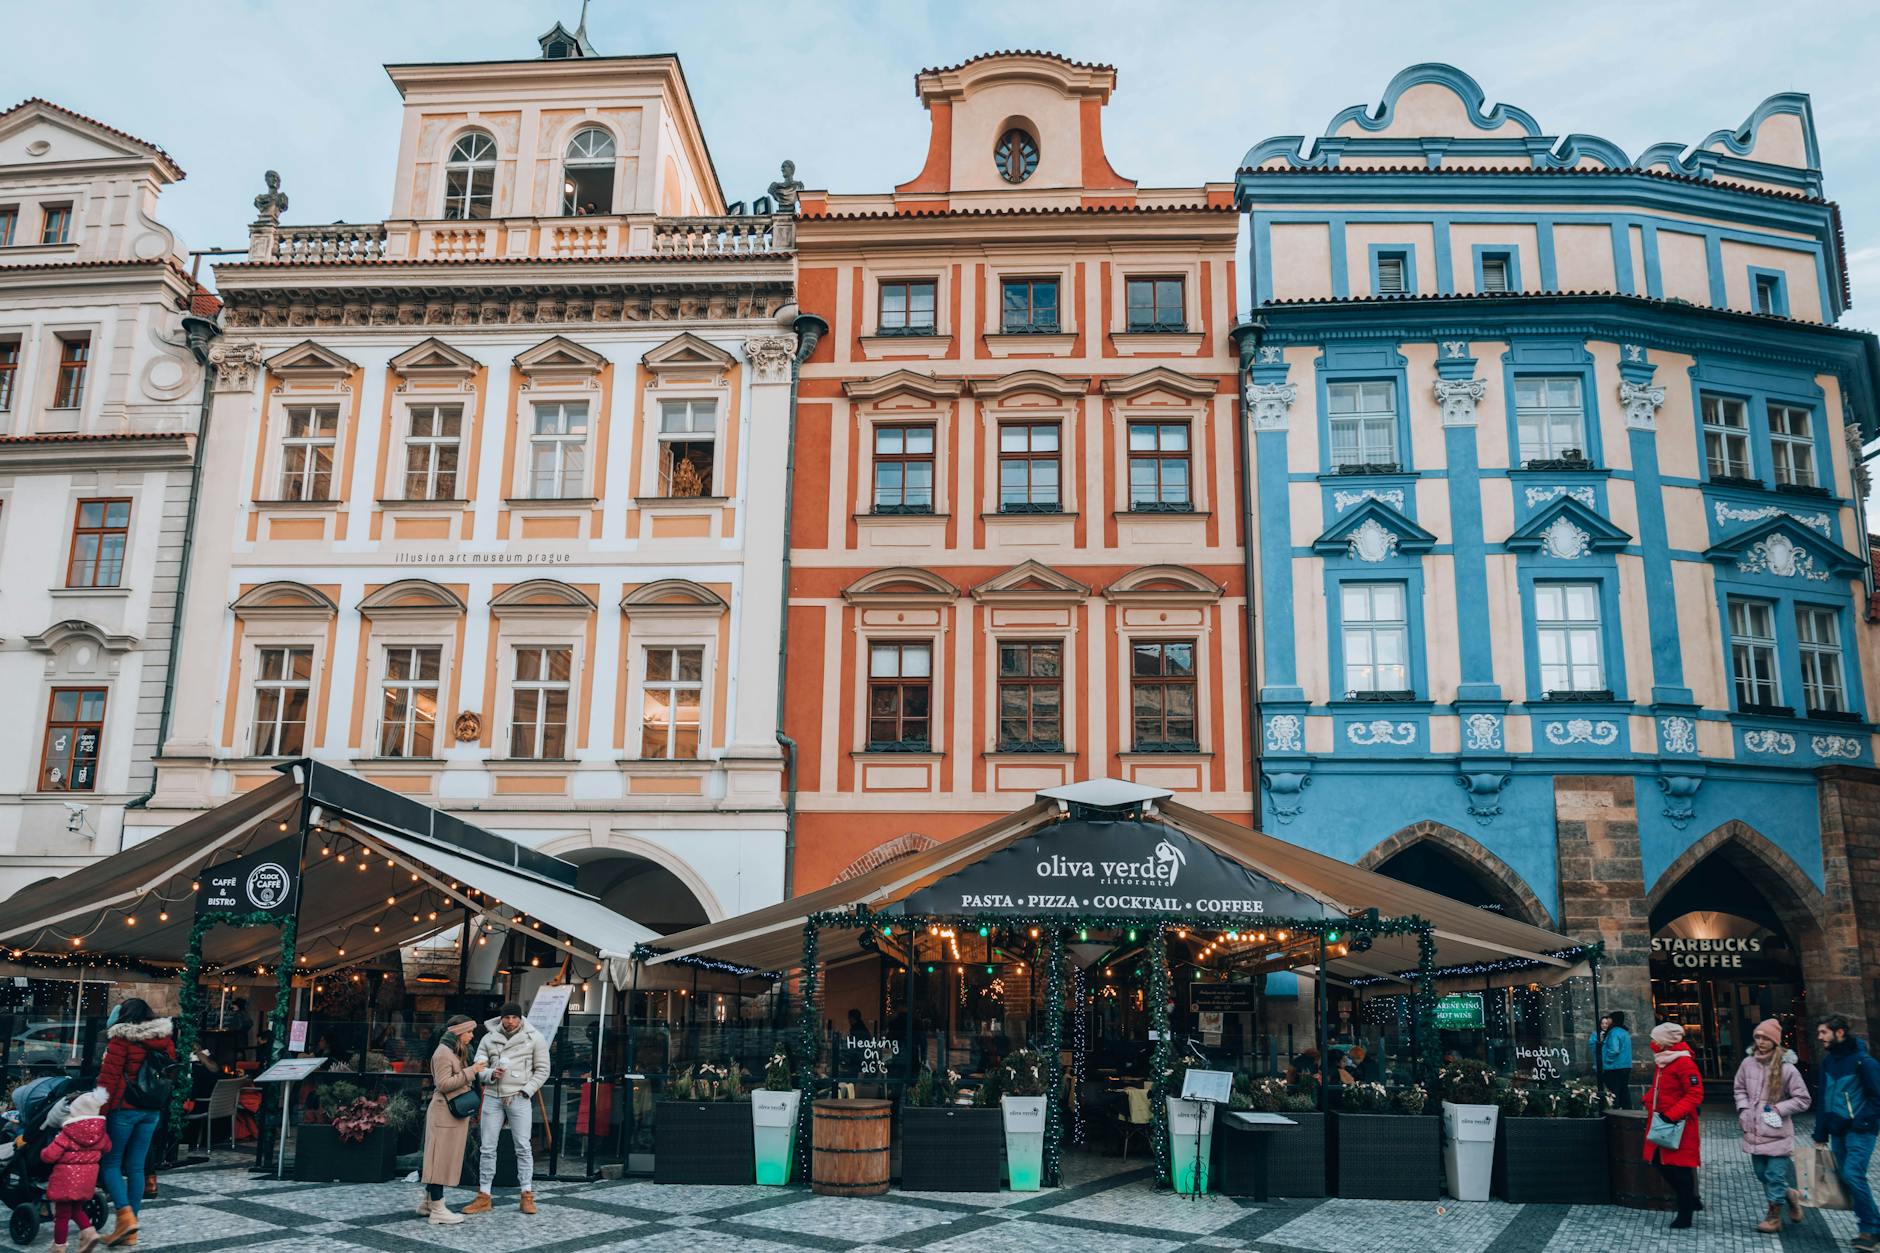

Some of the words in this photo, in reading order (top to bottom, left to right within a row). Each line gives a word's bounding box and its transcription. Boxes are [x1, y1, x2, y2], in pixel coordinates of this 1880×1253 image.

[395, 552, 444, 563] illusion
[449, 553, 466, 562] art
[473, 553, 523, 562] museum
[527, 553, 570, 564] prague
[1036, 854, 1095, 877] oliva
[1100, 856, 1169, 879] verde
[1100, 877, 1169, 887] ristorante
[219, 888, 227, 896] &
[208, 898, 236, 906] BISTRO
[961, 894, 1015, 908] PASTA
[1028, 895, 1079, 908] PIZZA
[1093, 895, 1182, 911] COCKTAIL
[1196, 899, 1264, 913] COFFEE
[1651, 938, 1761, 952] STARBUCKS
[1673, 954, 1742, 968] COFFEE
[847, 1036, 899, 1055] Heating
[864, 1048, 879, 1060] On
[1516, 1046, 1570, 1066] Heating
[1536, 1056, 1552, 1068] On
